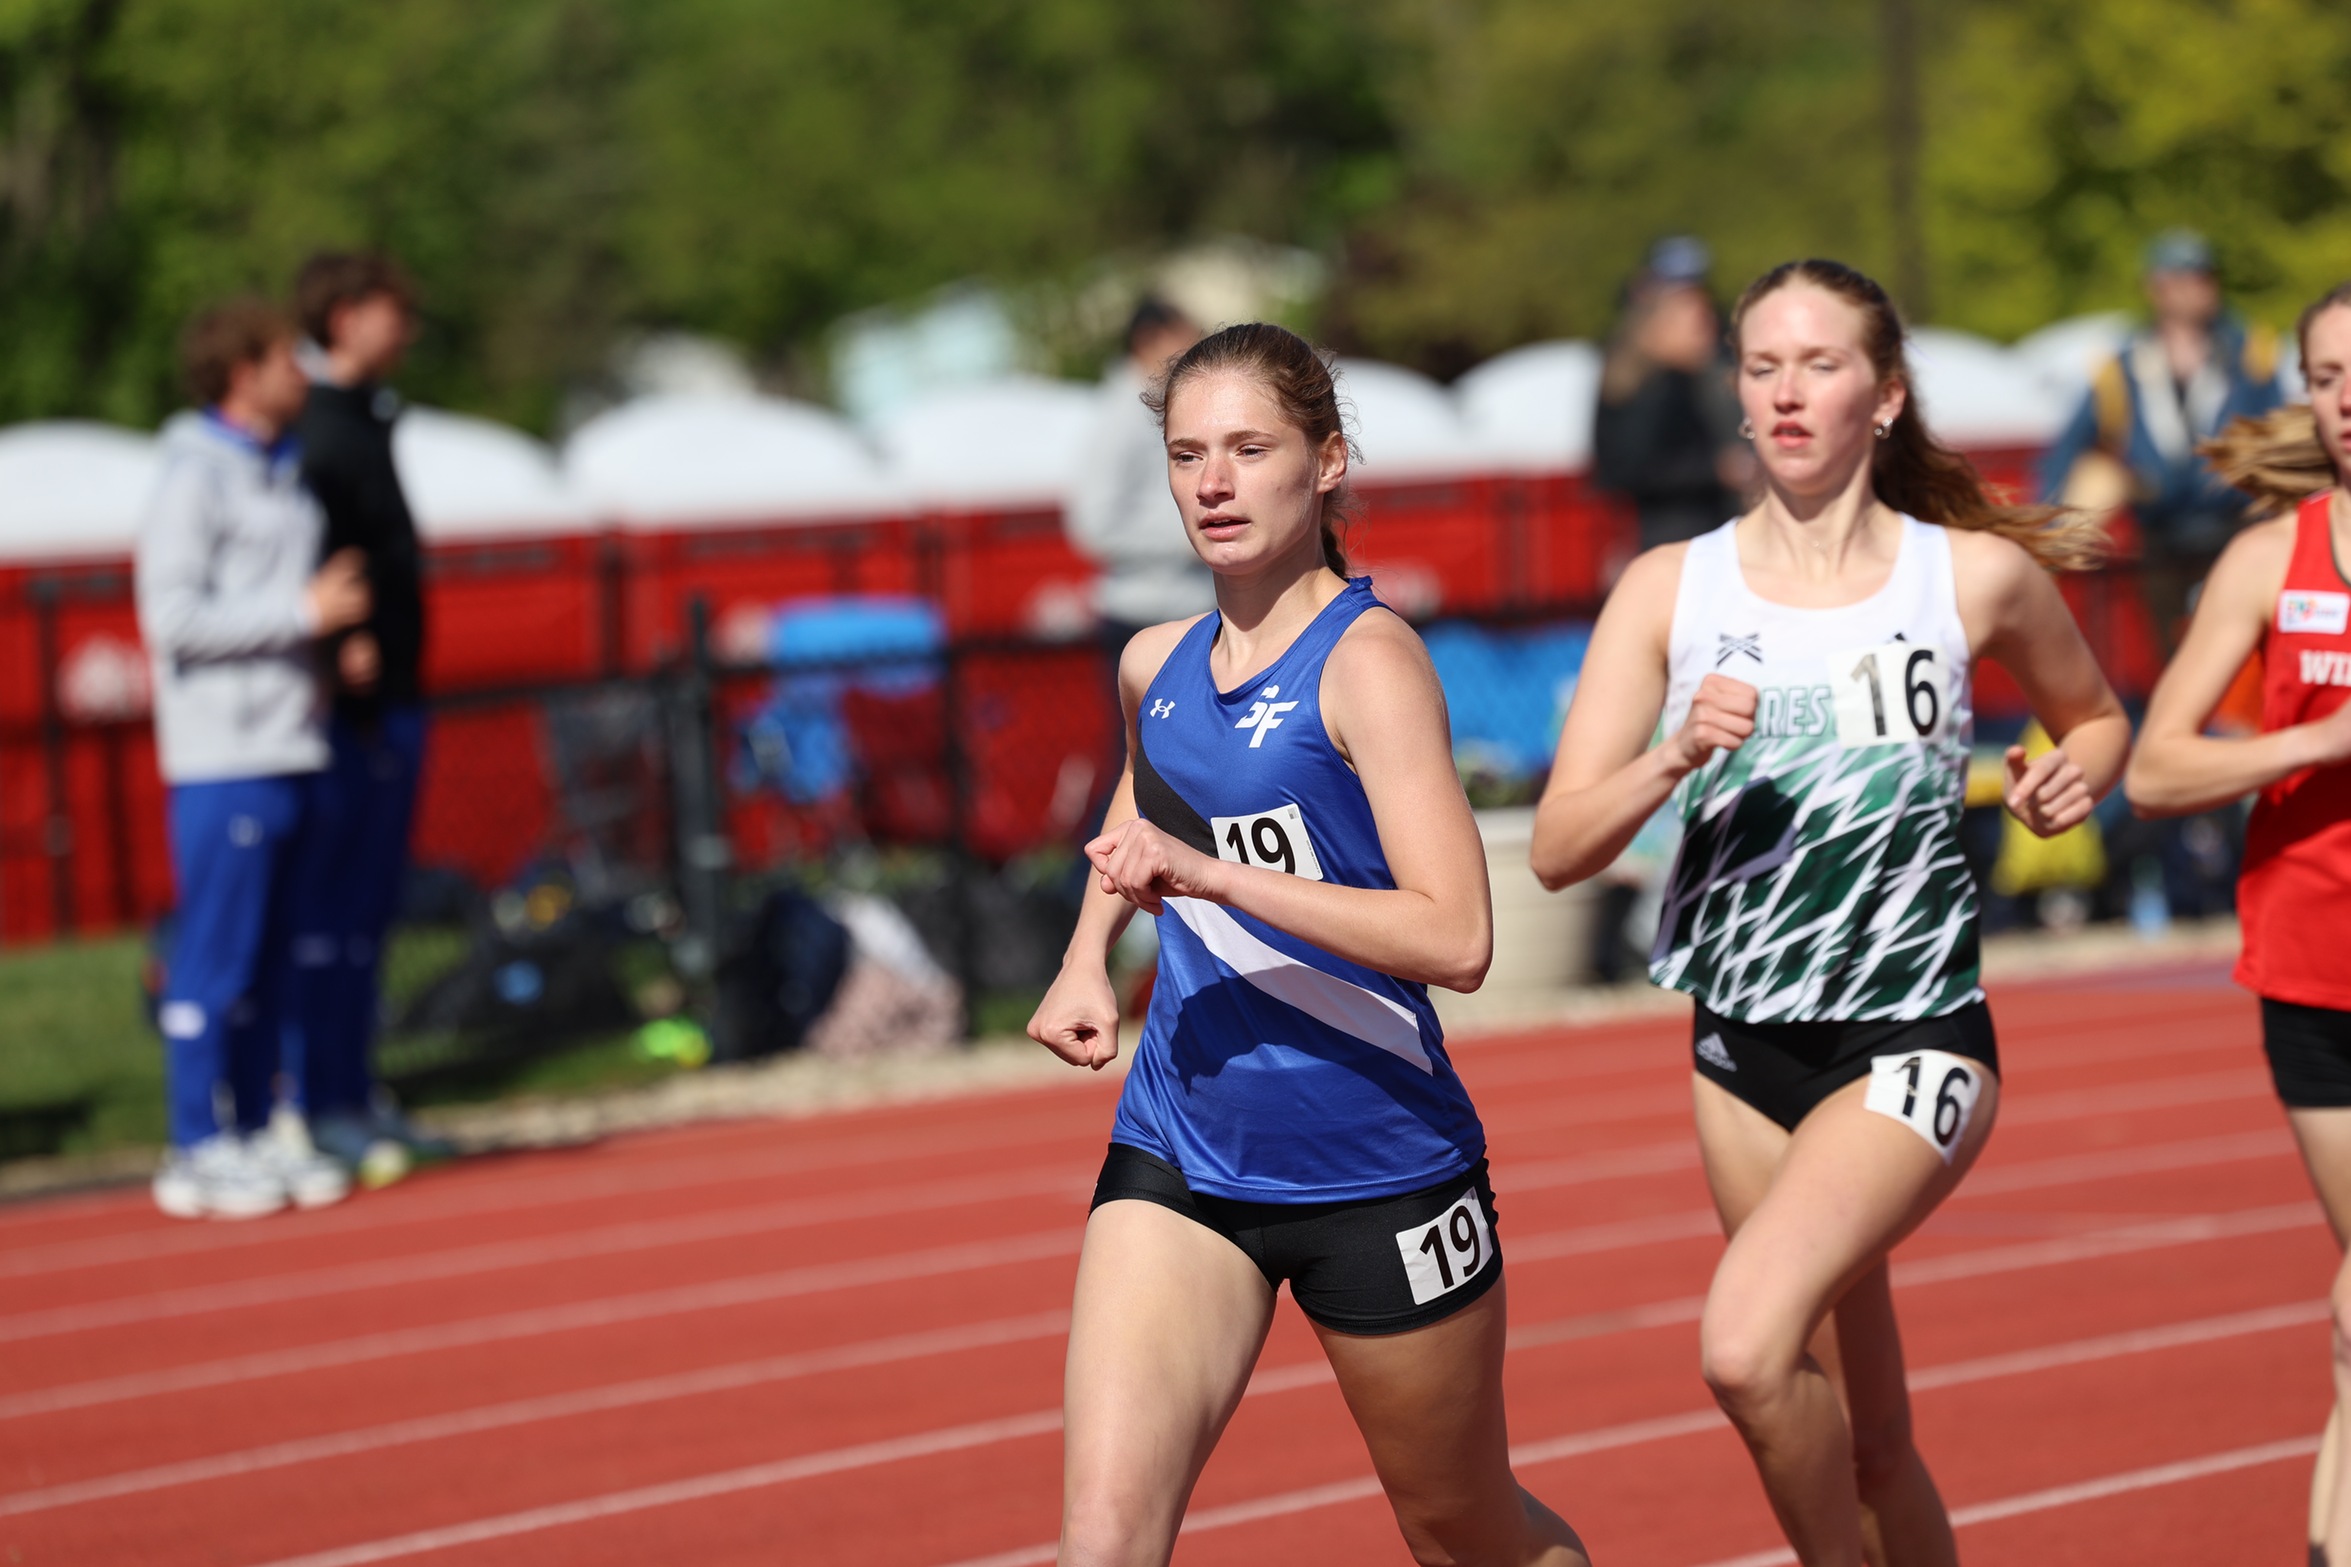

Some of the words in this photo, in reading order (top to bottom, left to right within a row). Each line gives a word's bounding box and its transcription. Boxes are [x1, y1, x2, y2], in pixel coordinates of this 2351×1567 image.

[1849, 649, 1938, 737] 16
[2300, 650, 2351, 687] WI
[1758, 685, 1836, 738] RES
[1226, 817, 1296, 875] 19
[1898, 1056, 1970, 1147] 16
[1419, 1205, 1481, 1290] 19
